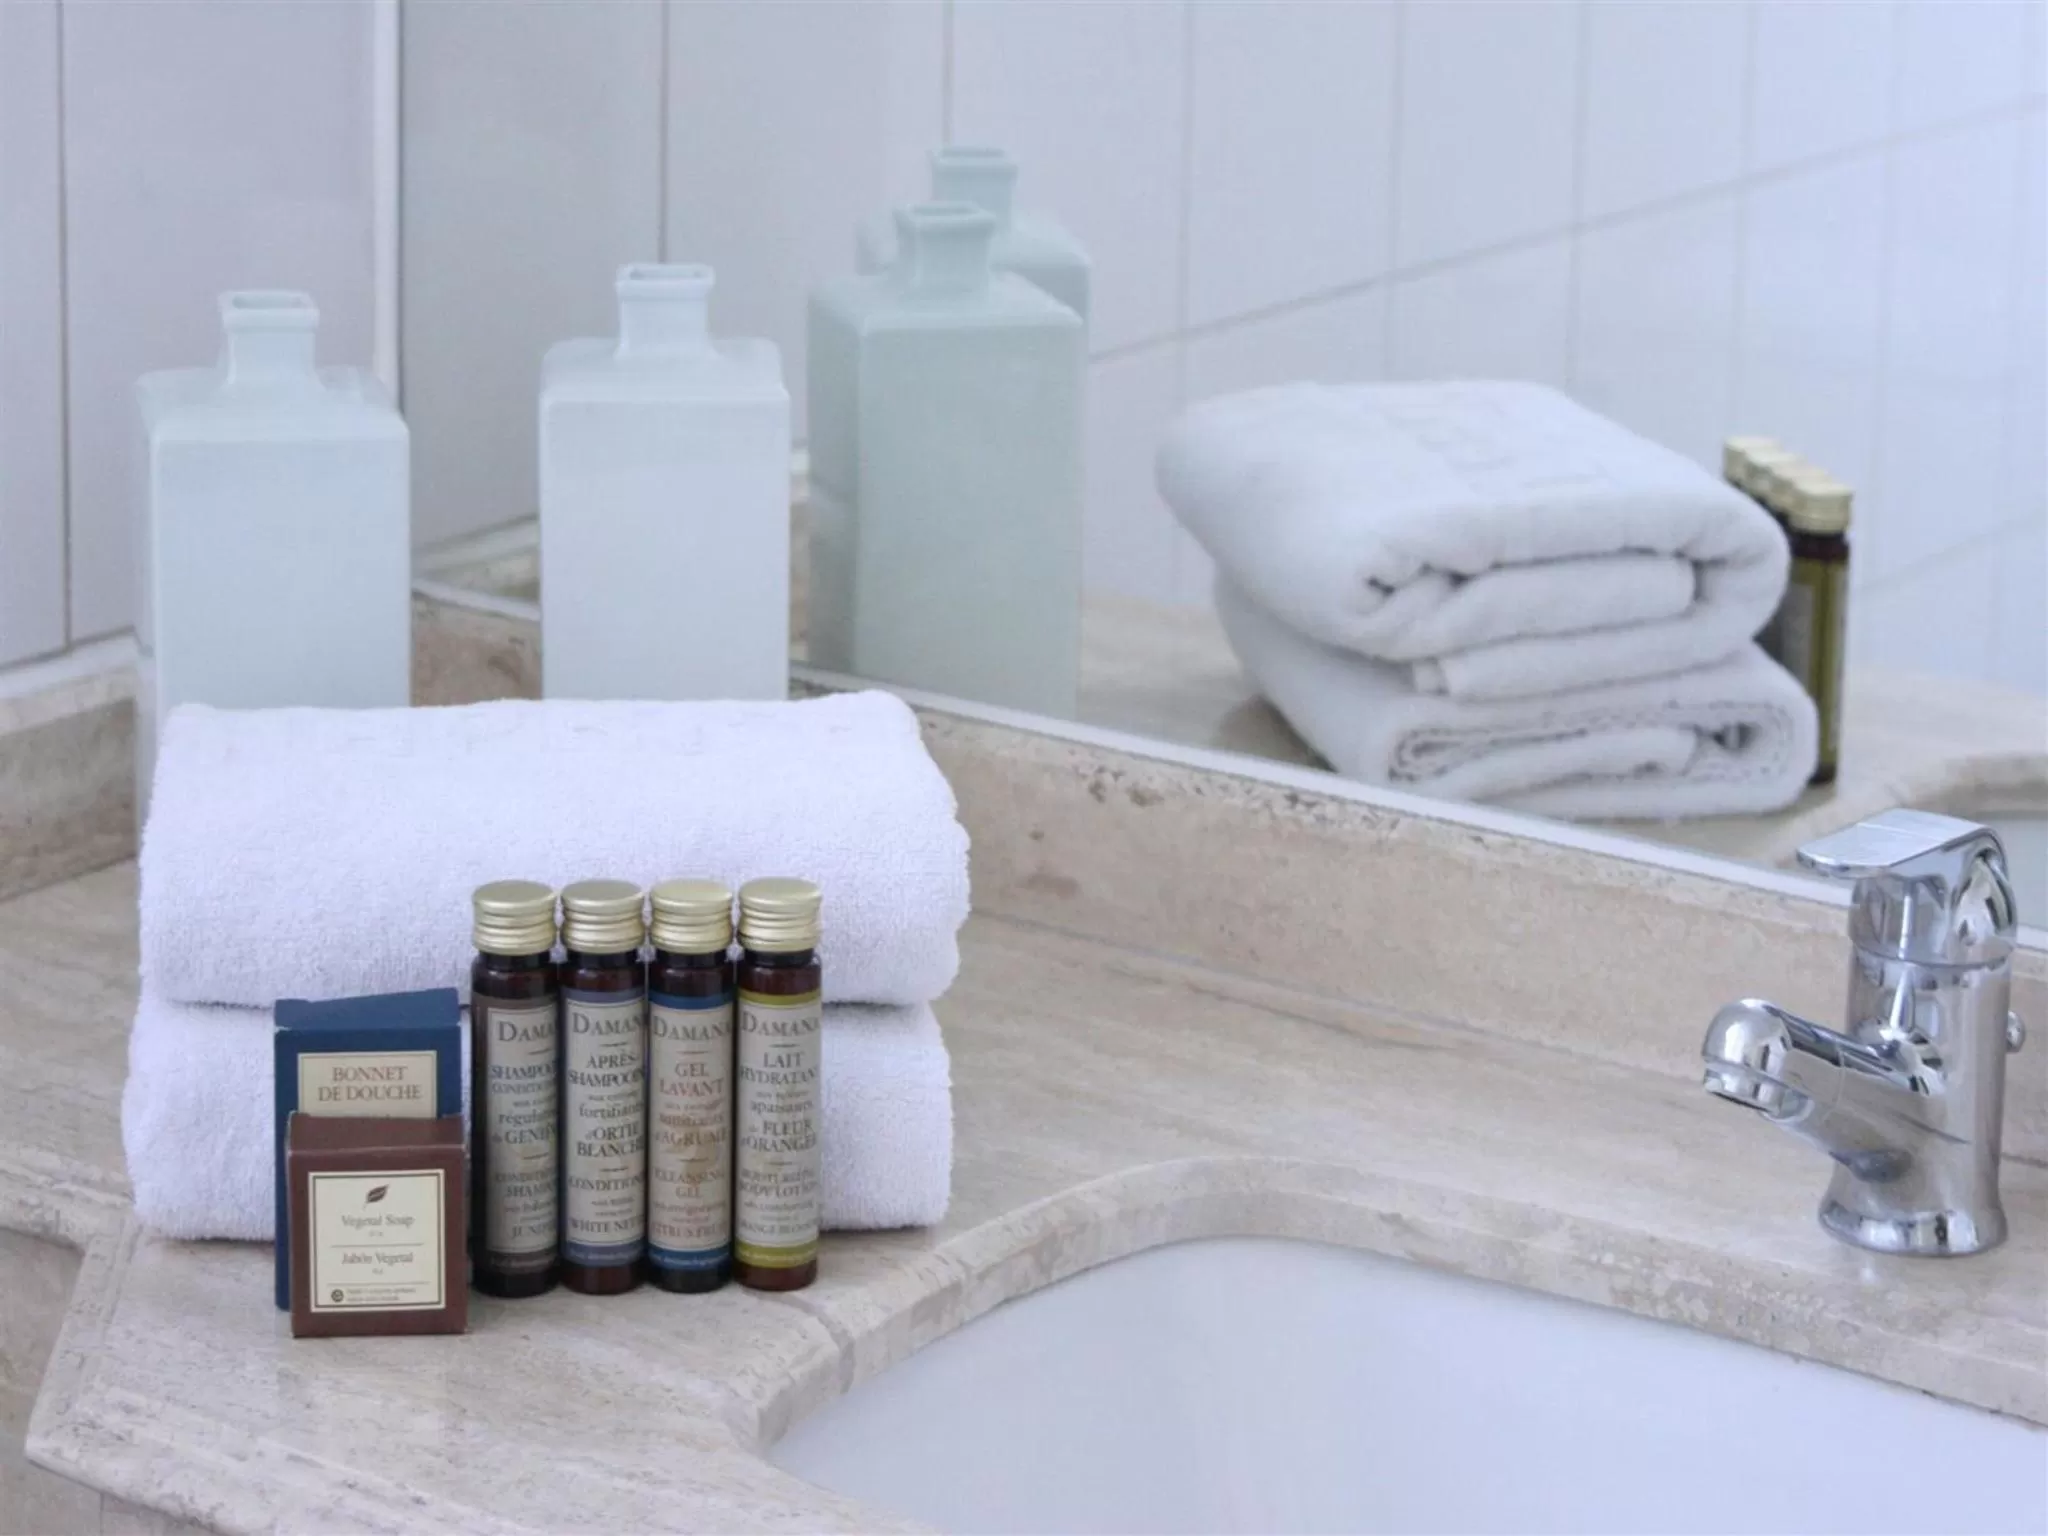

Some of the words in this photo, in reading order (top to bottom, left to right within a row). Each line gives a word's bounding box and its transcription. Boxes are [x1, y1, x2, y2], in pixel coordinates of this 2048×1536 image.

[763, 1052, 805, 1069] LAIT
[332, 1066, 408, 1082] BONNET
[675, 1062, 710, 1077] GEL
[318, 1086, 341, 1101] DE
[346, 1084, 422, 1100] DOUCHE
[659, 1077, 724, 1097] LAVANT
[764, 1119, 814, 1137] FLEUR
[341, 1215, 382, 1230] Vegetal
[385, 1213, 415, 1229] Soap
[375, 1252, 413, 1266] Vegetal
